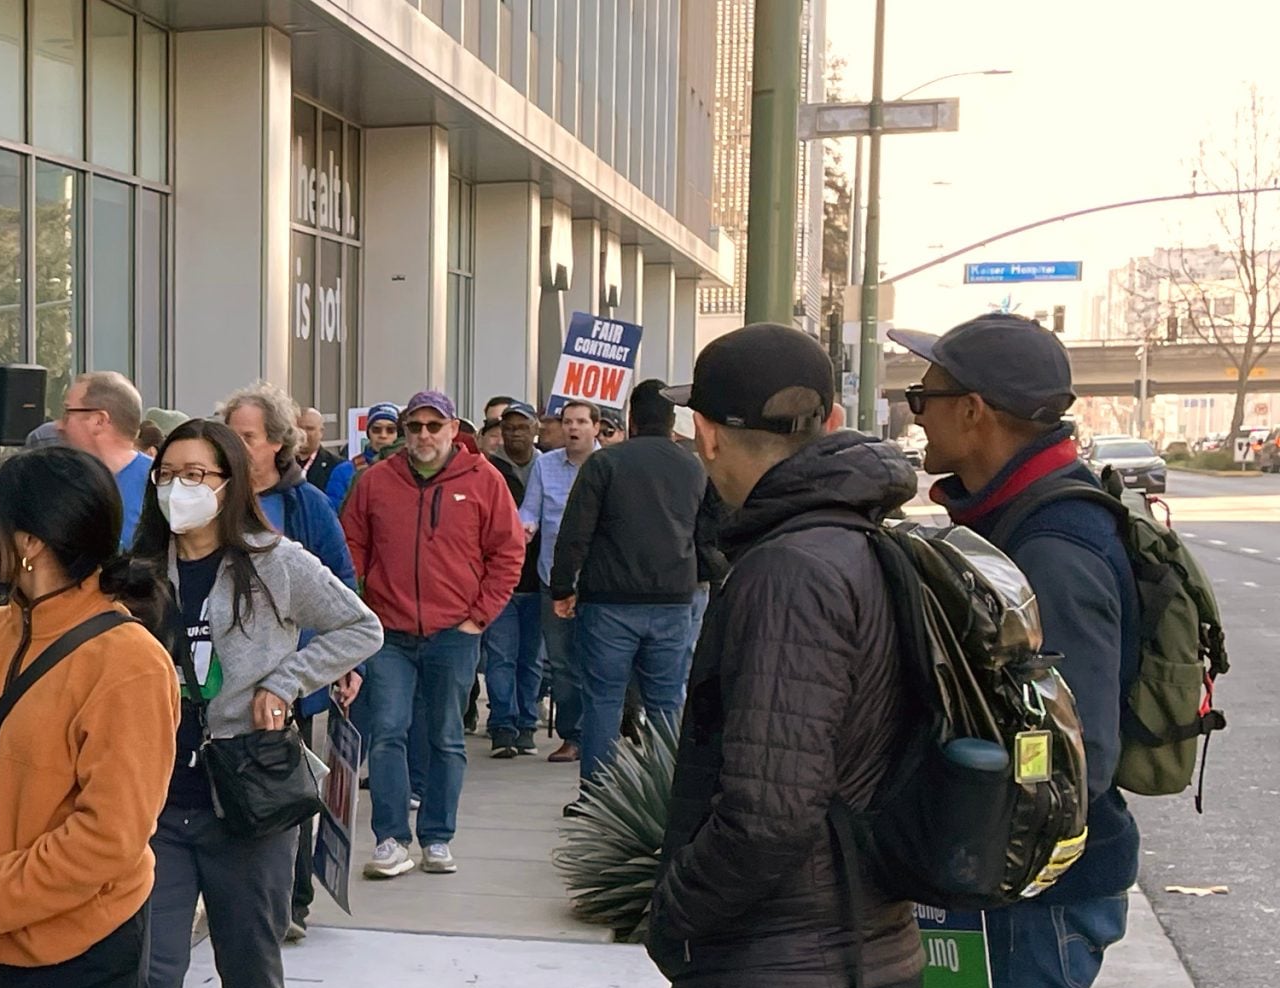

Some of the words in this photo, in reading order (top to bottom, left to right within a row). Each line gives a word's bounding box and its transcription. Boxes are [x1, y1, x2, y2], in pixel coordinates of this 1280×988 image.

[295, 256, 311, 341] is
[574, 336, 631, 362] CONTRACT
[591, 319, 624, 344] FAIR
[563, 361, 626, 402] NOW
[927, 937, 960, 973] Our
